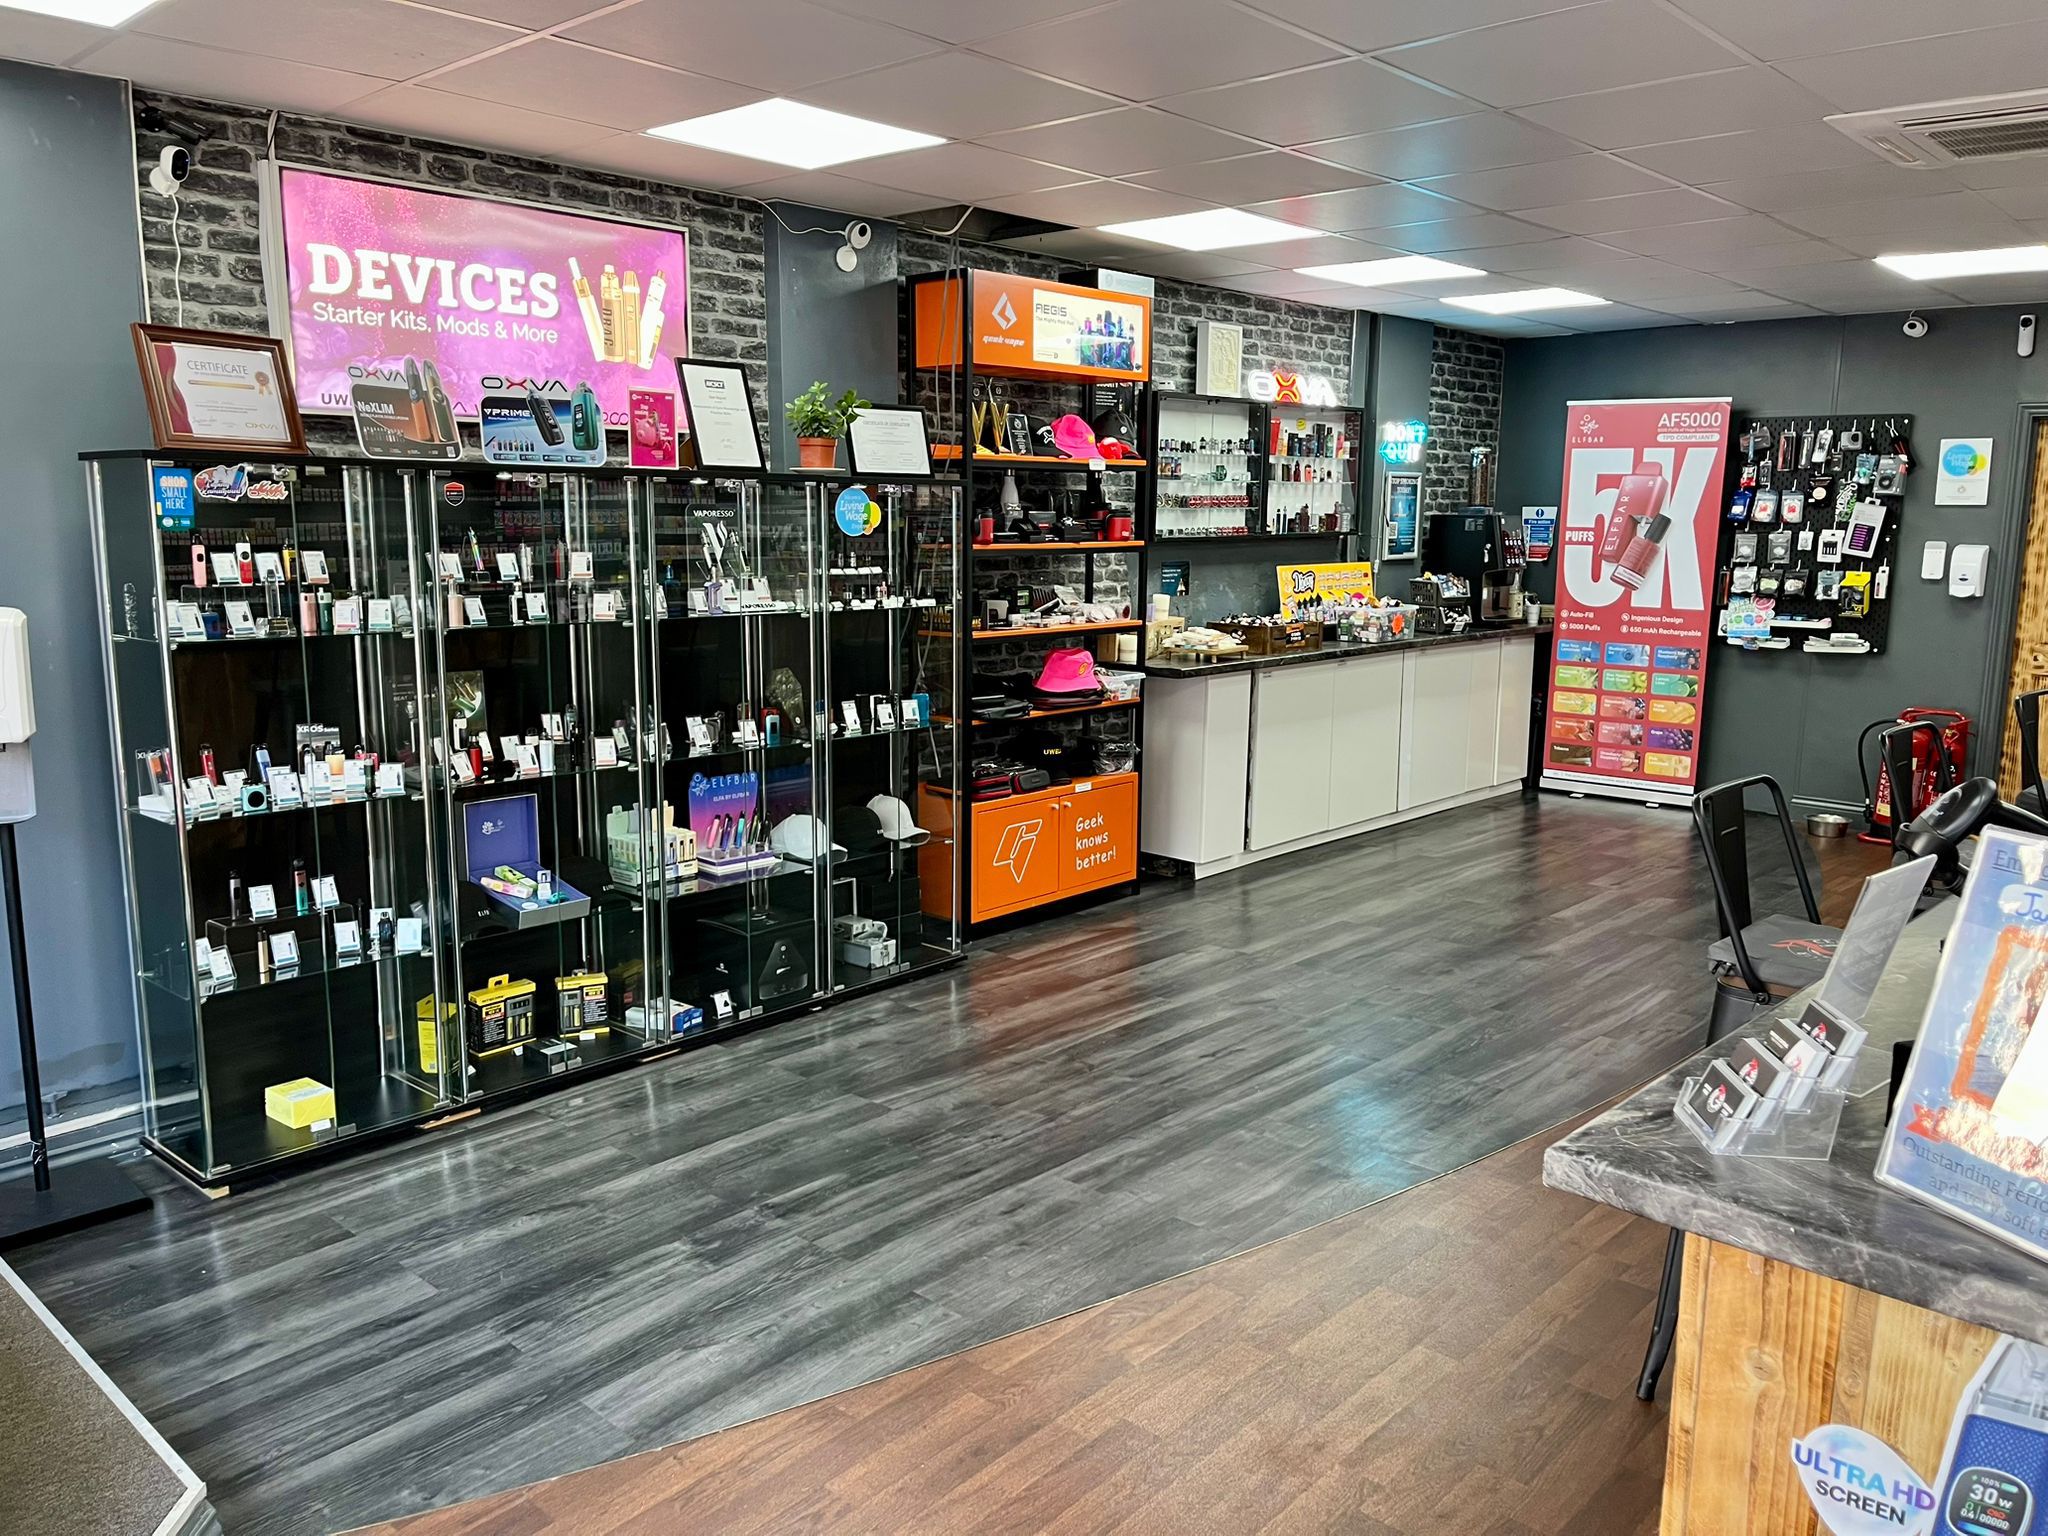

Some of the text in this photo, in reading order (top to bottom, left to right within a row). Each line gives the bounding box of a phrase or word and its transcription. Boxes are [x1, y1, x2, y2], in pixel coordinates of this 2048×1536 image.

[306, 243, 559, 319] DEVICES
[1035, 302, 1067, 317] AEGIS
[314, 302, 385, 327] Starter
[436, 314, 488, 337] Mods
[494, 321, 508, 338] &
[513, 323, 559, 344] More
[187, 360, 249, 375] CERTIFICATE
[348, 366, 406, 383] OXVA
[481, 377, 568, 392] OXVA
[357, 401, 395, 415] NeXLIM
[245, 422, 278, 430] OXVA
[1657, 411, 1722, 427] AF5000
[161, 487, 187, 499] SMALL
[165, 498, 186, 510] HERE
[840, 500, 865, 512] Living
[693, 509, 734, 518] VAPORESSO
[845, 510, 868, 522] Wage
[1565, 530, 1595, 542] PUFFS
[1585, 623, 1600, 631] Puffs
[1631, 615, 1683, 624] Ingenious Design
[1659, 628, 1702, 637] Rechargeable
[712, 773, 756, 788] ELFBAR
[1076, 812, 1104, 832] Geek
[1076, 831, 1109, 850] knows
[1076, 845, 1116, 871] better!
[1903, 1136, 2002, 1195] Outstanding
[1929, 1175, 1960, 1194] and
[2003, 1210, 2036, 1236] soft
[1794, 1442, 1936, 1512] ULTRA HD
[1981, 1476, 2000, 1489] 100%
[1816, 1479, 1906, 1527] SCREEN
[1980, 1513, 2011, 1531] 00000
